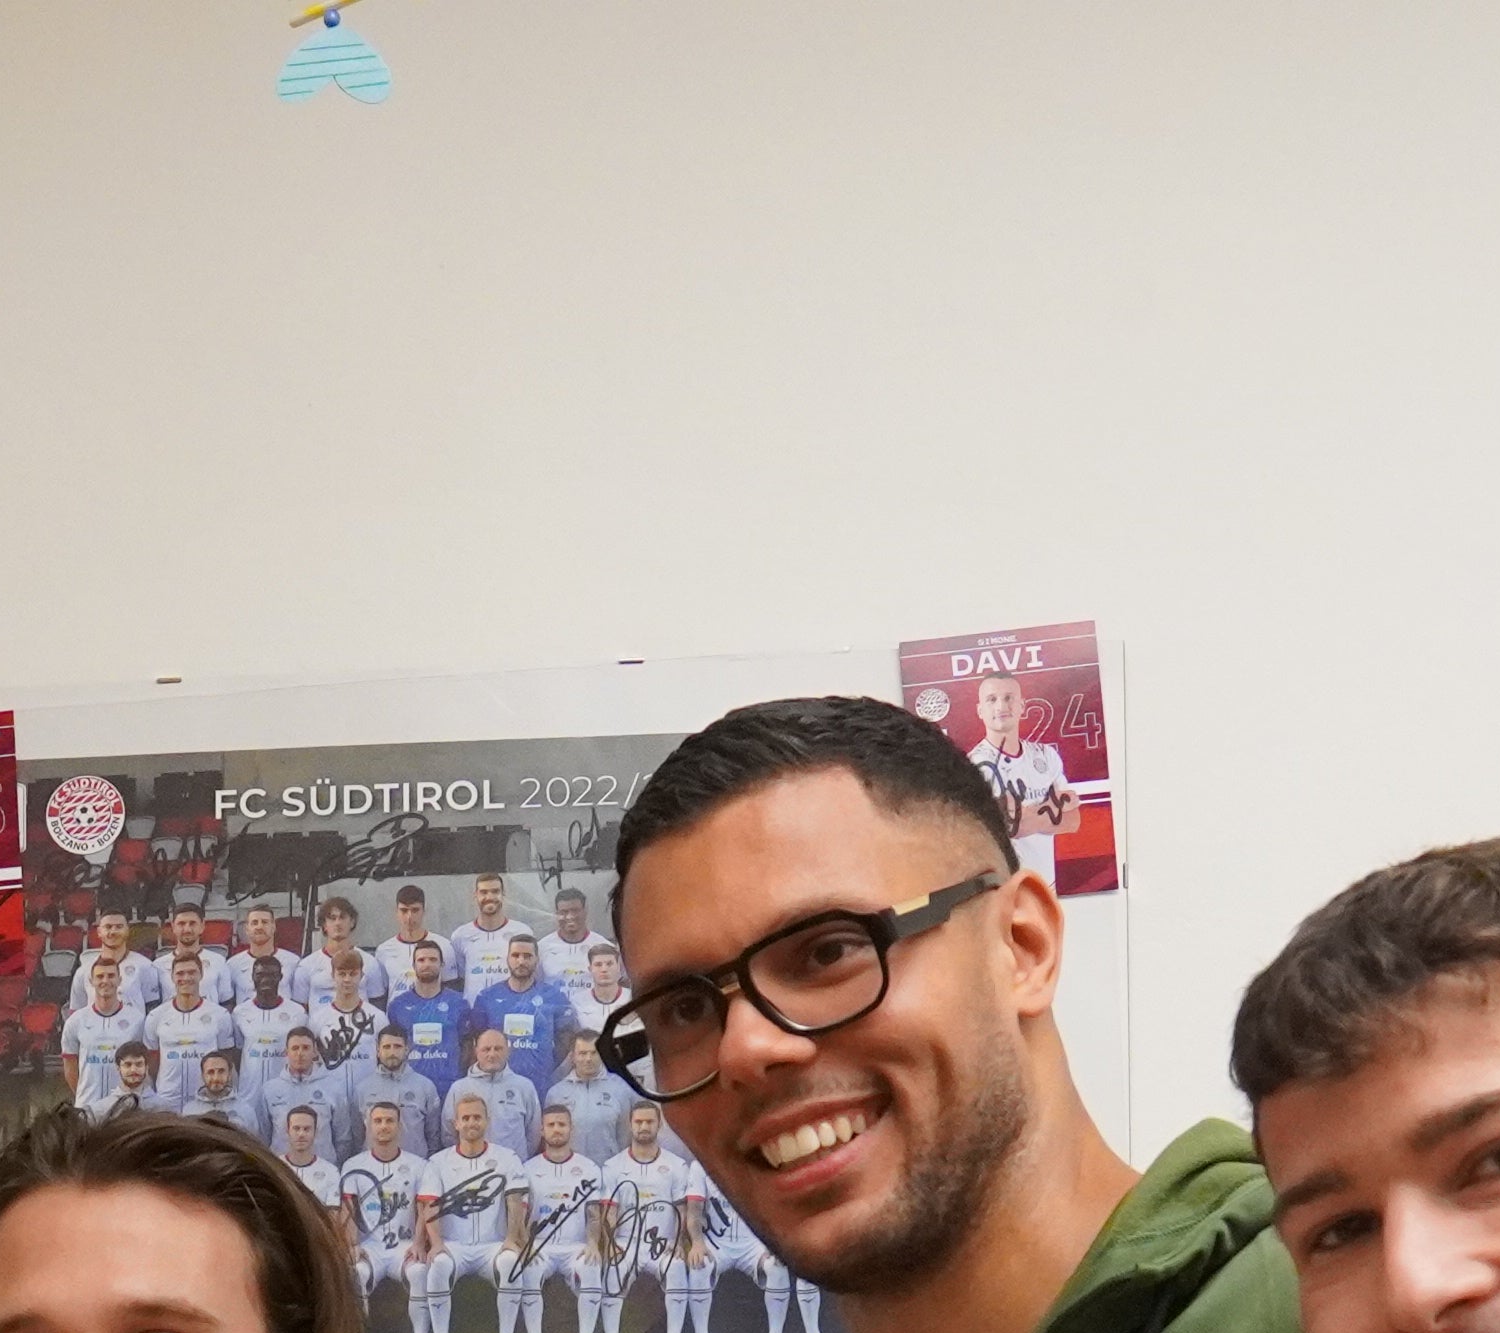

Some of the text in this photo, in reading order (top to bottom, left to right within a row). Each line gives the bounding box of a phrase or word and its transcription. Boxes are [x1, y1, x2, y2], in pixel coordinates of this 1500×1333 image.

[951, 645, 1044, 677] DAVI
[214, 789, 267, 819] FC
[282, 777, 505, 817] SÜDTIROL
[51, 816, 120, 851] BOLZANO BOZEN
